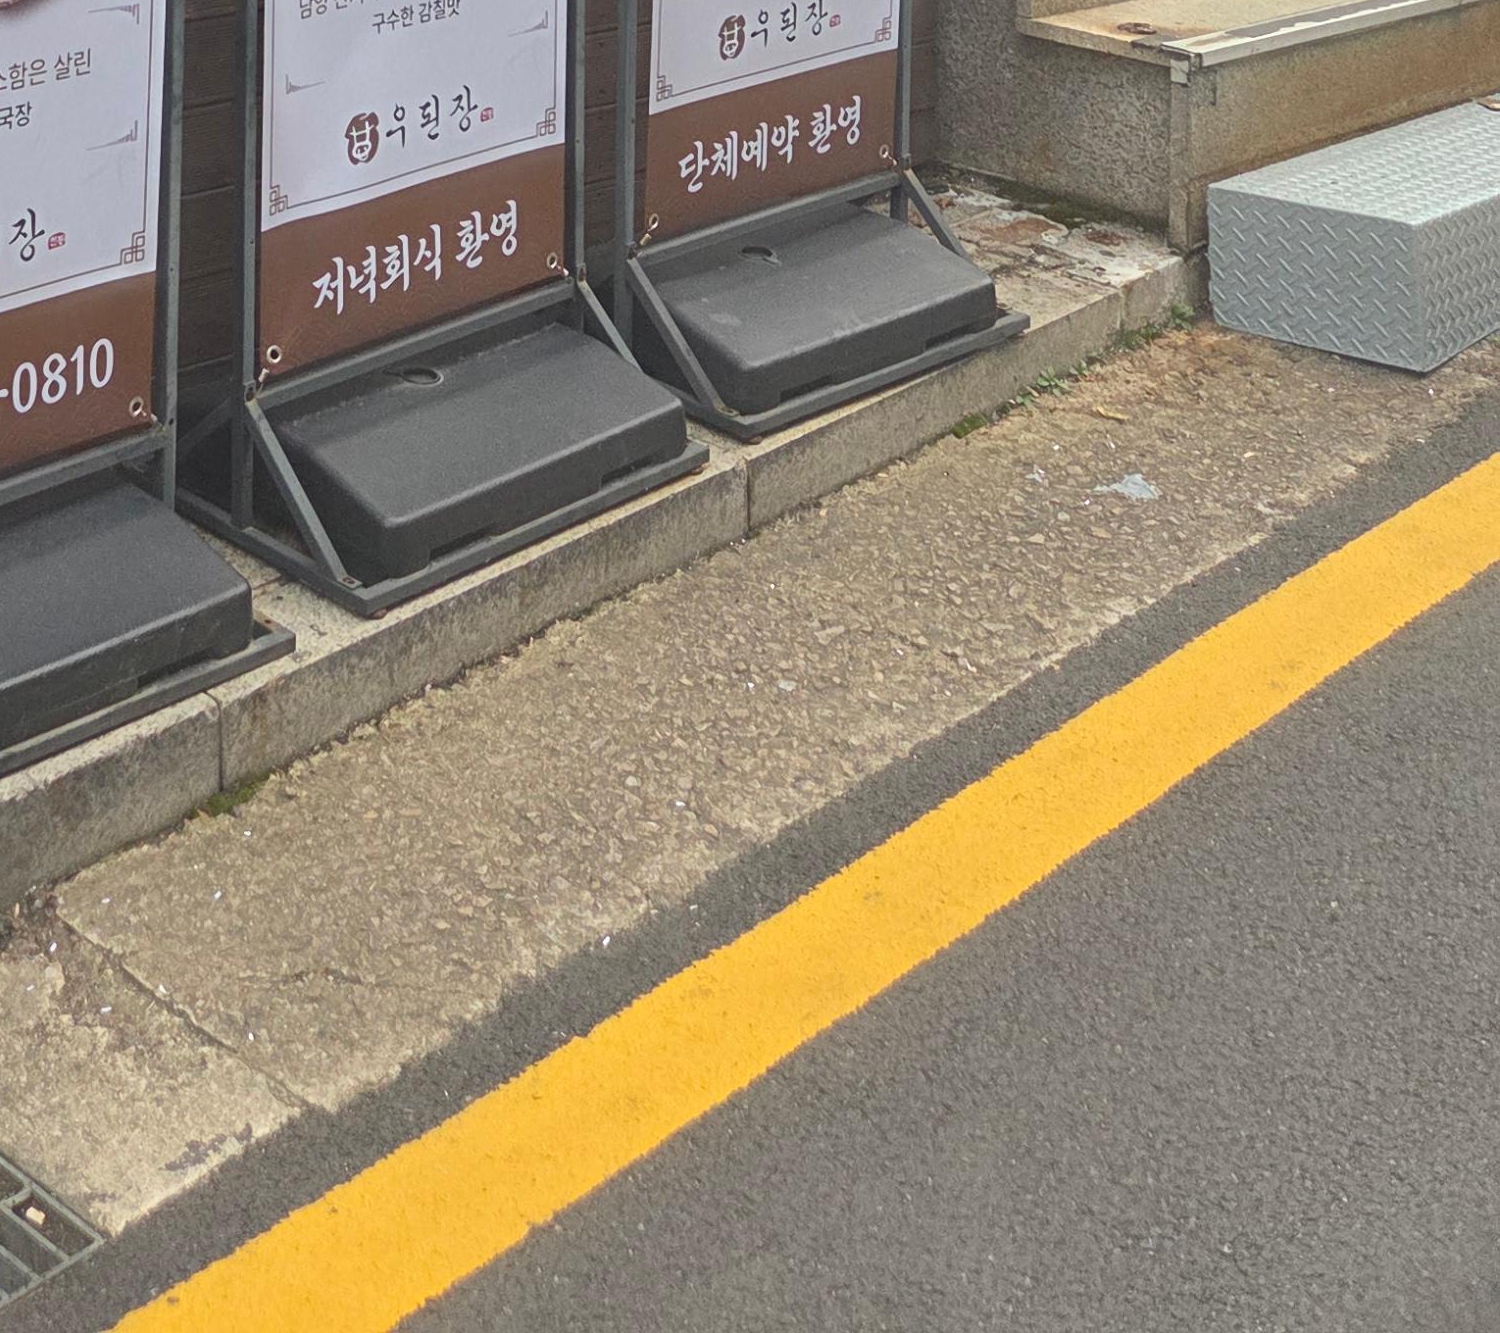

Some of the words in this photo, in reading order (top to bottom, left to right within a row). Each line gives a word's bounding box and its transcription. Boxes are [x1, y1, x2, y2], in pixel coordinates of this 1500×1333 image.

[371, 3, 415, 33] 구수한
[53, 47, 93, 77] 살린
[677, 114, 800, 194] 단체예약
[807, 94, 862, 155] 환영
[311, 223, 443, 316] 저녁회식
[454, 198, 518, 270] 환영
